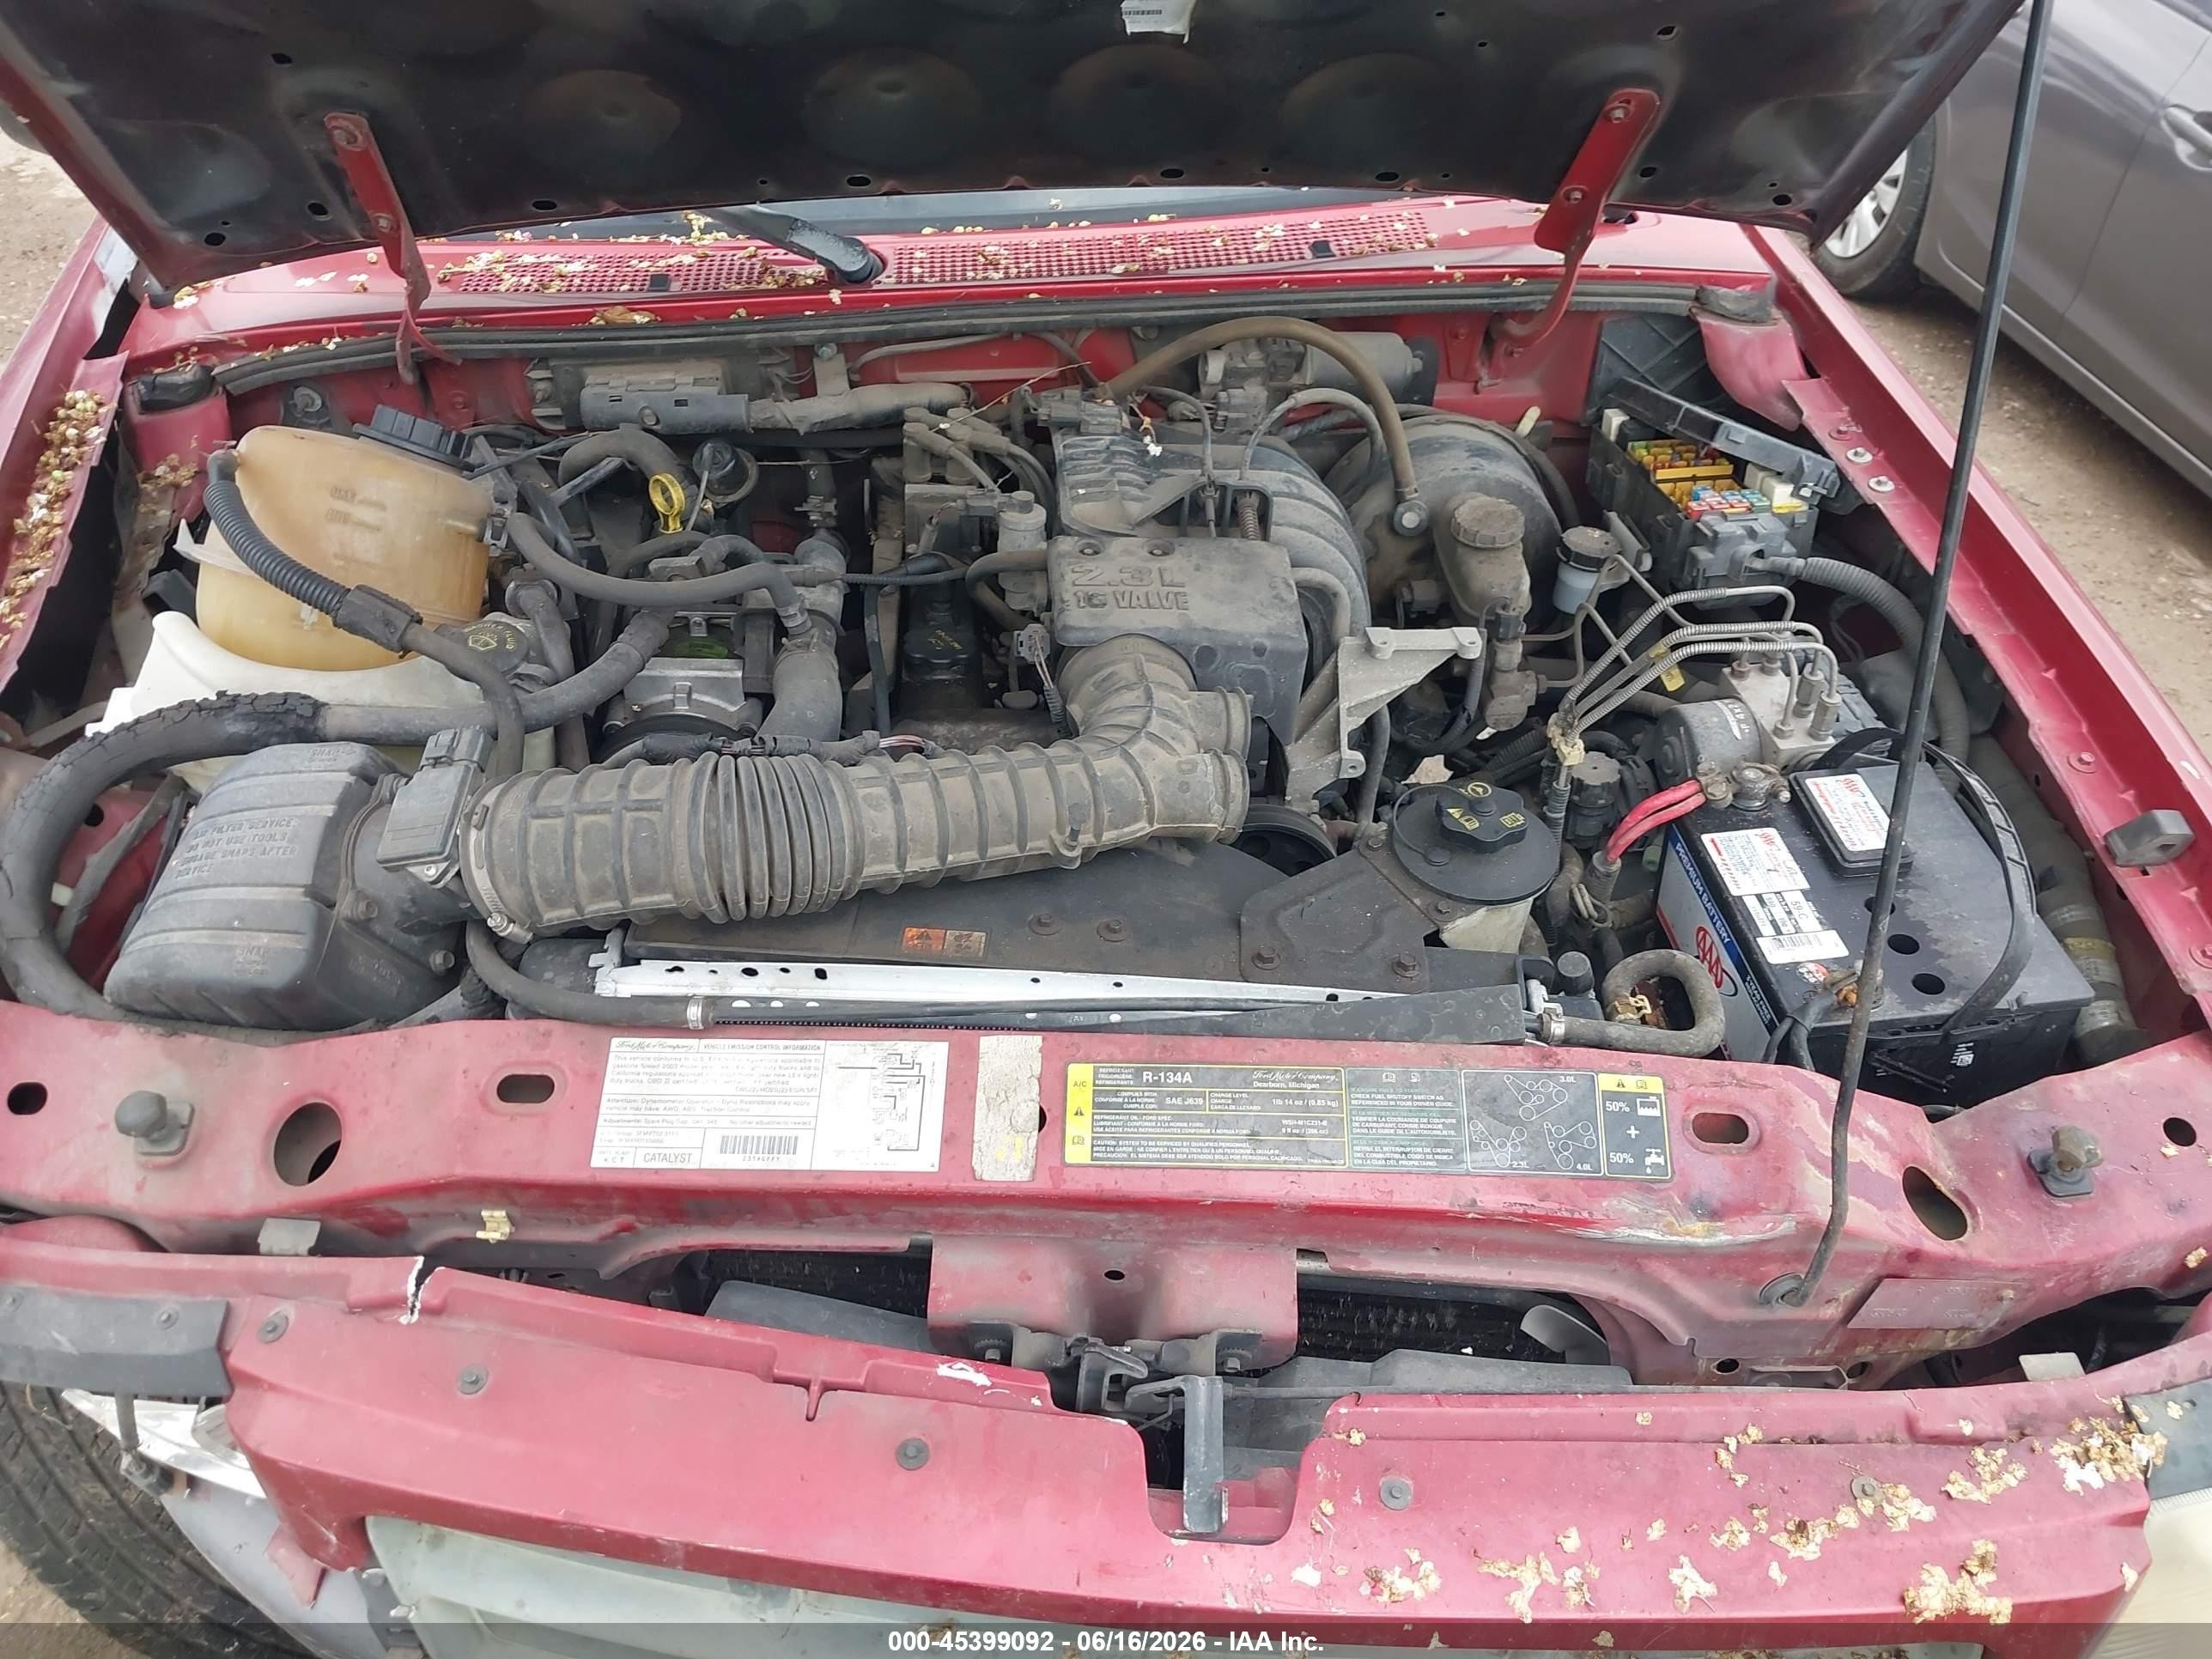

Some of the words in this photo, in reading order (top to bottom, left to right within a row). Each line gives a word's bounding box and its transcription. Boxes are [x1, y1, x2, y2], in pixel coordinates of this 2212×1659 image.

[1072, 565, 1186, 587] 2.3L
[1113, 591, 1189, 610] VALVE
[226, 836, 246, 846] USE
[252, 832, 288, 843] TOOLS
[259, 846, 297, 857] AFTER
[1676, 842, 1704, 897] PREMIUM
[1702, 893, 1730, 944] BATTERY
[1143, 1071, 1194, 1084] R-134A
[1605, 1100, 1630, 1113] 50%
[644, 1152, 693, 1164] CATALYST
[1609, 1152, 1634, 1164] 50%
